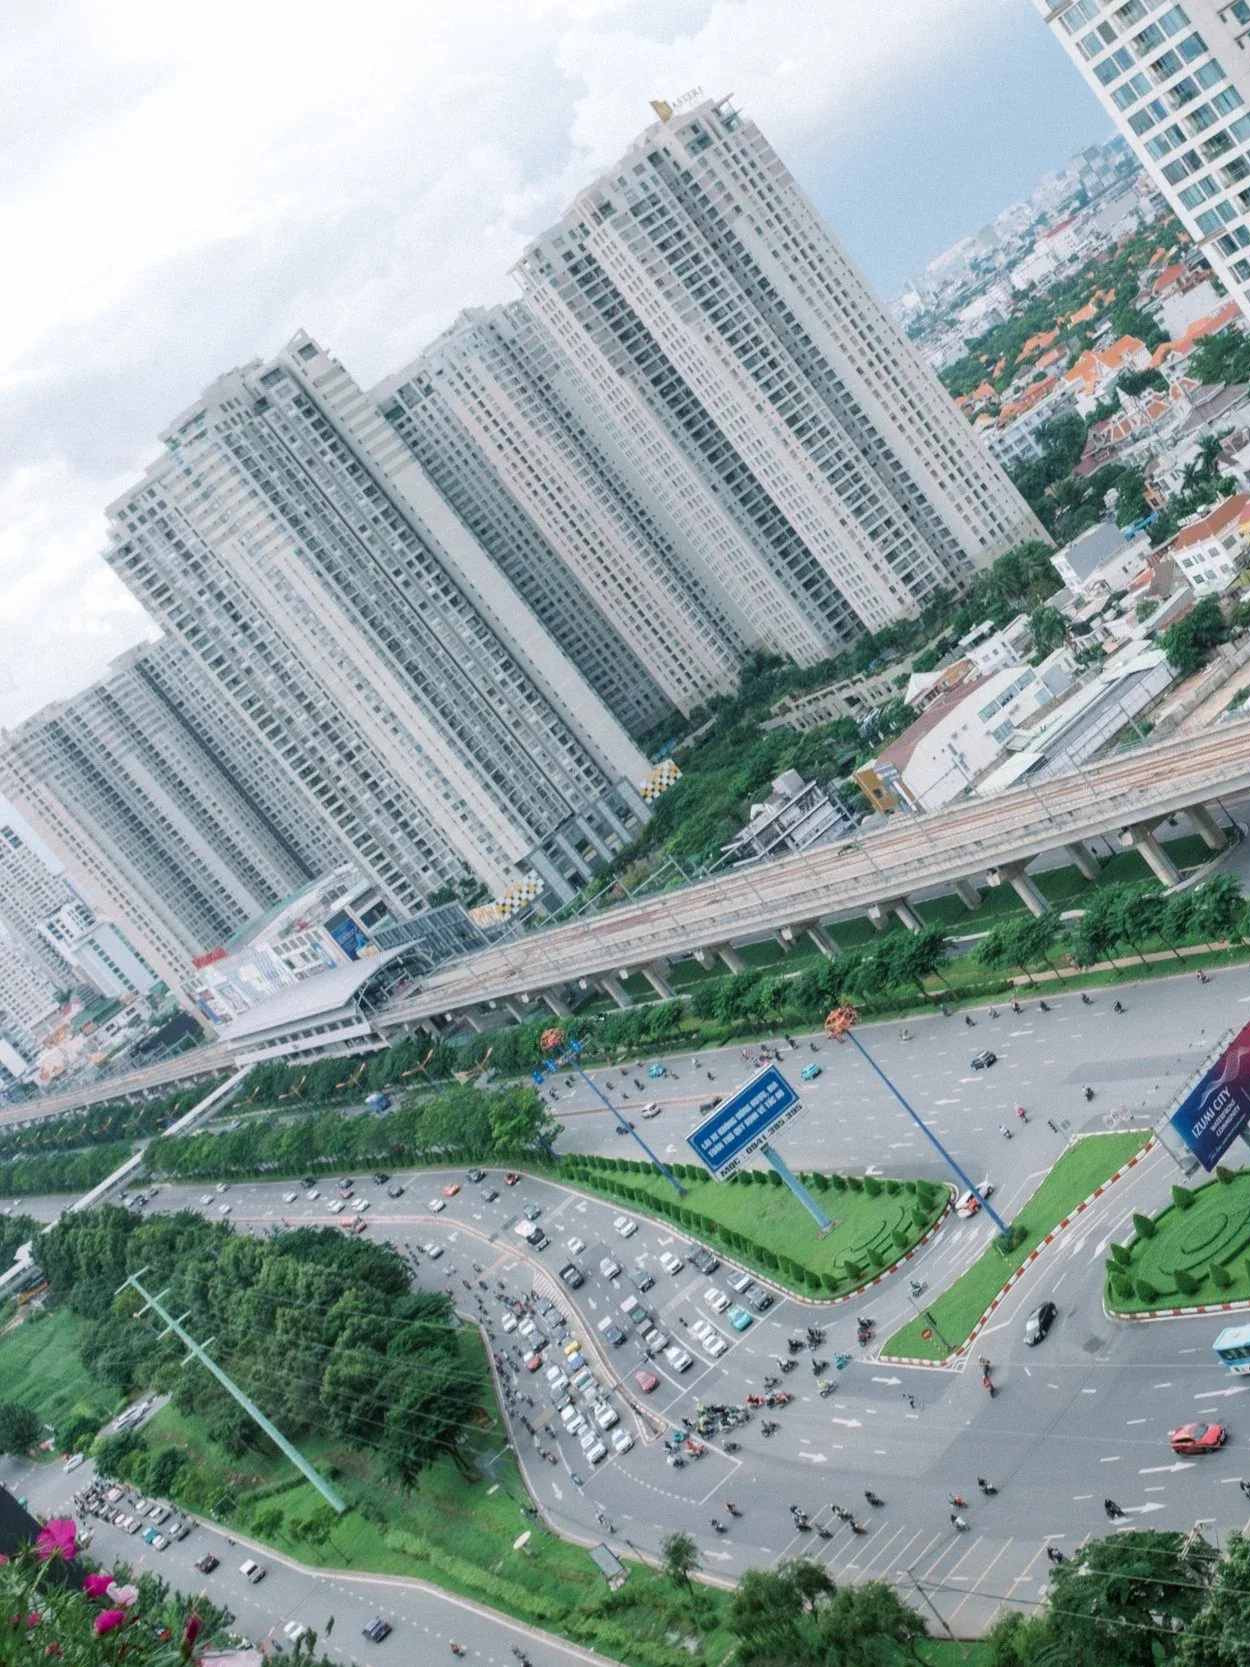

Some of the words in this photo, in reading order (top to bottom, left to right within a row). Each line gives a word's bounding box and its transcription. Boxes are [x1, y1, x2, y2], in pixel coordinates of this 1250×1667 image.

[1191, 1106, 1216, 1139] IZUMI
[1213, 1085, 1231, 1111] CITY
[1210, 1098, 1236, 1132] WATERFRONT
[1216, 1103, 1241, 1137] COMMUNITY
[720, 1157, 741, 1177] MQC
